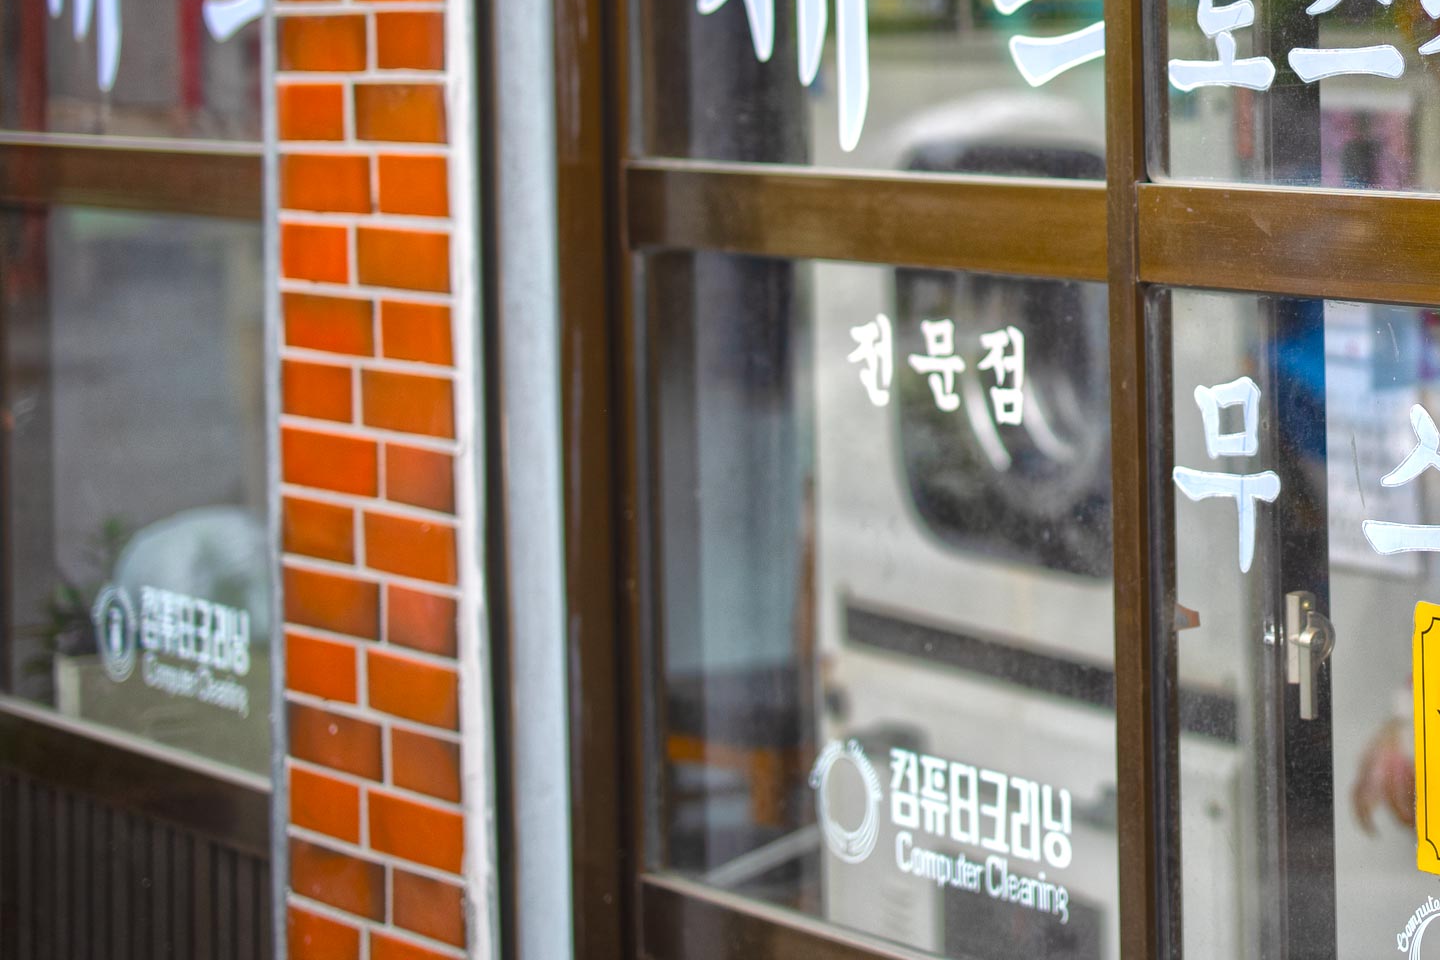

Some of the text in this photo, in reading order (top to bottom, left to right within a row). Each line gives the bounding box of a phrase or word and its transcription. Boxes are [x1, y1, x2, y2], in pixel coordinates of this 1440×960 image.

[848, 313, 1024, 426] 전문점
[890, 748, 1072, 868] 컴퓨터크리닝
[895, 830, 1069, 924] Computer Cleaning
